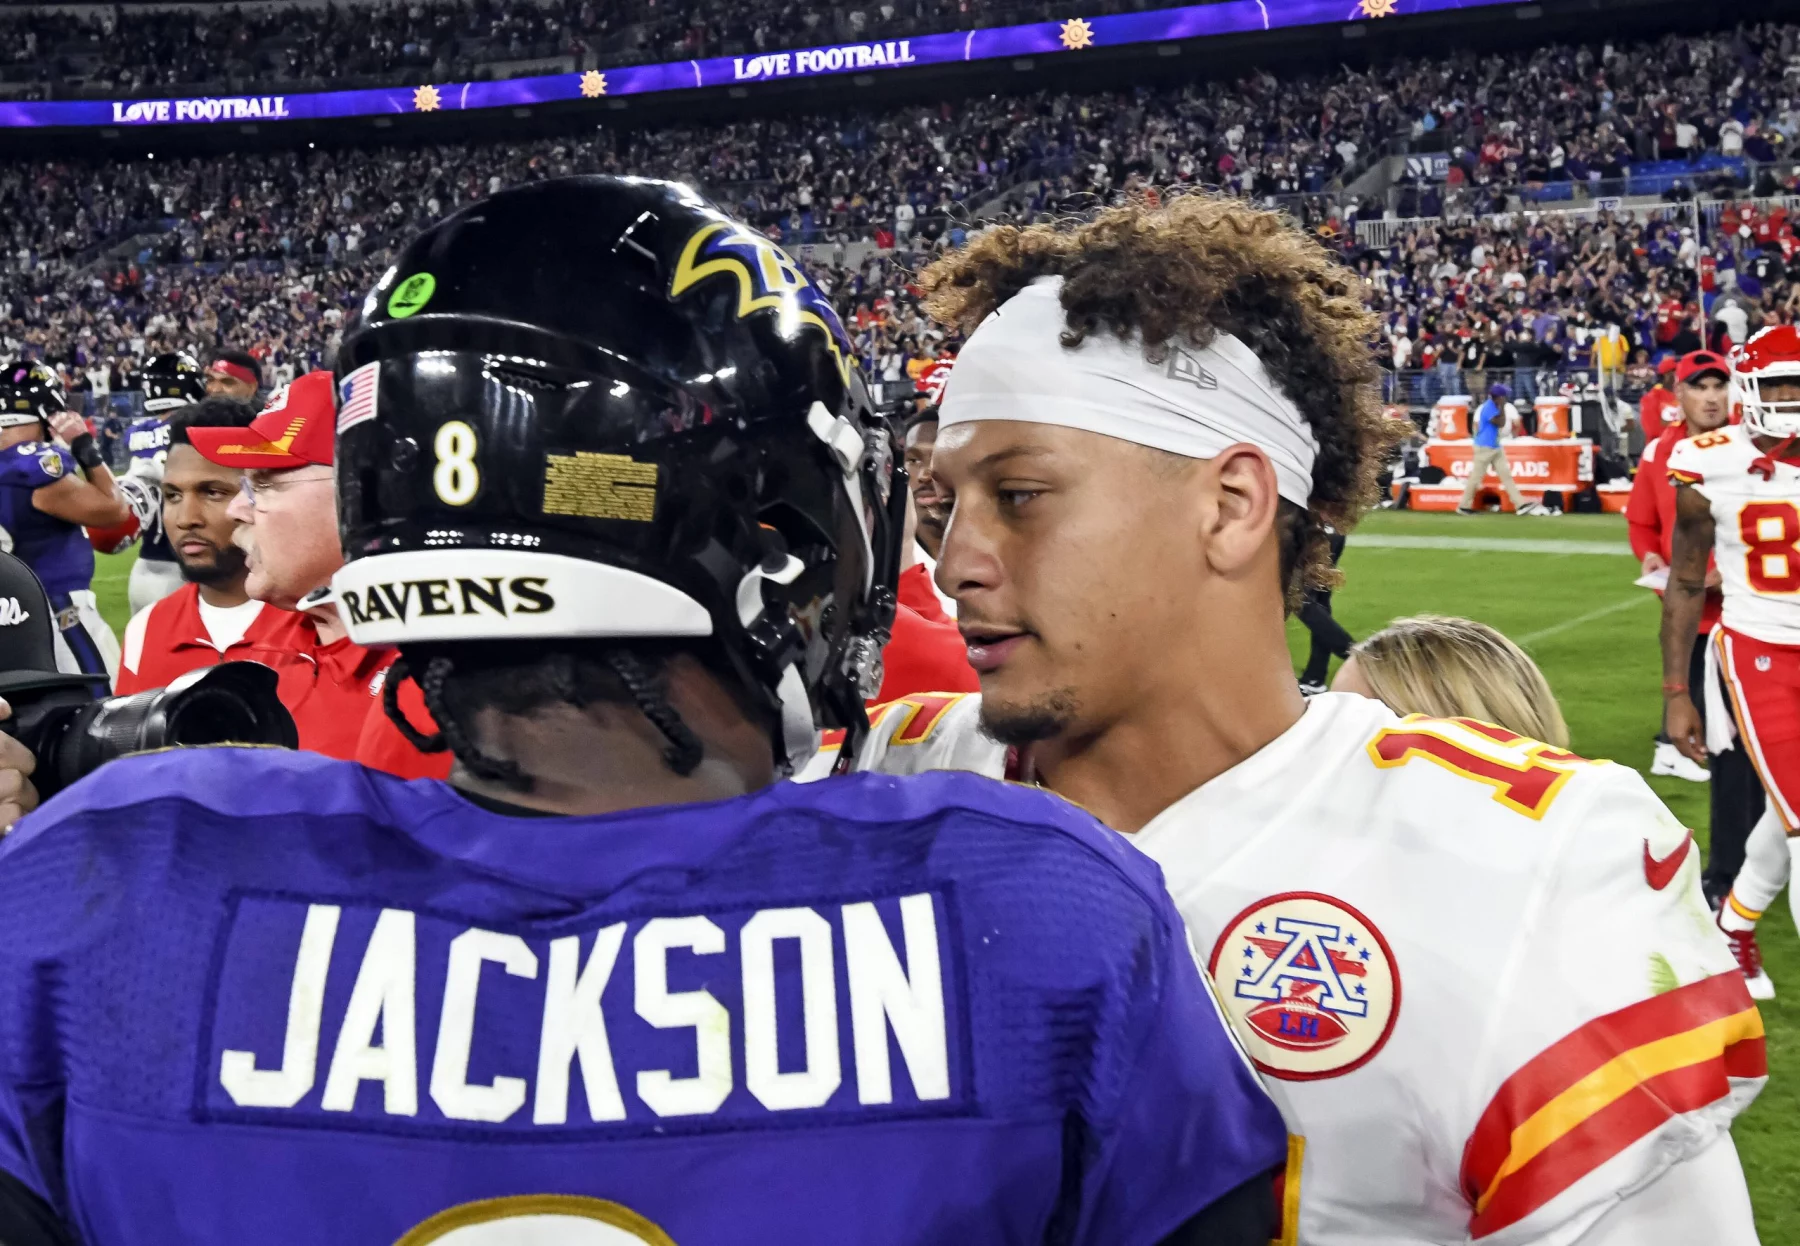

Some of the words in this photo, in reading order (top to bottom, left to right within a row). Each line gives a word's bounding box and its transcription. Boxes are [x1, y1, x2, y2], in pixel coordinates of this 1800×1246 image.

[733, 53, 791, 80] LOVE
[795, 40, 915, 74] FOOTBALL
[112, 101, 170, 122] LOVE
[175, 97, 289, 121] FOOTBALL
[434, 420, 480, 507] 8
[341, 576, 555, 627] RAVENS
[1234, 917, 1369, 1019] A
[219, 893, 951, 1126] JACKSON
[1278, 1012, 1320, 1038] LH
